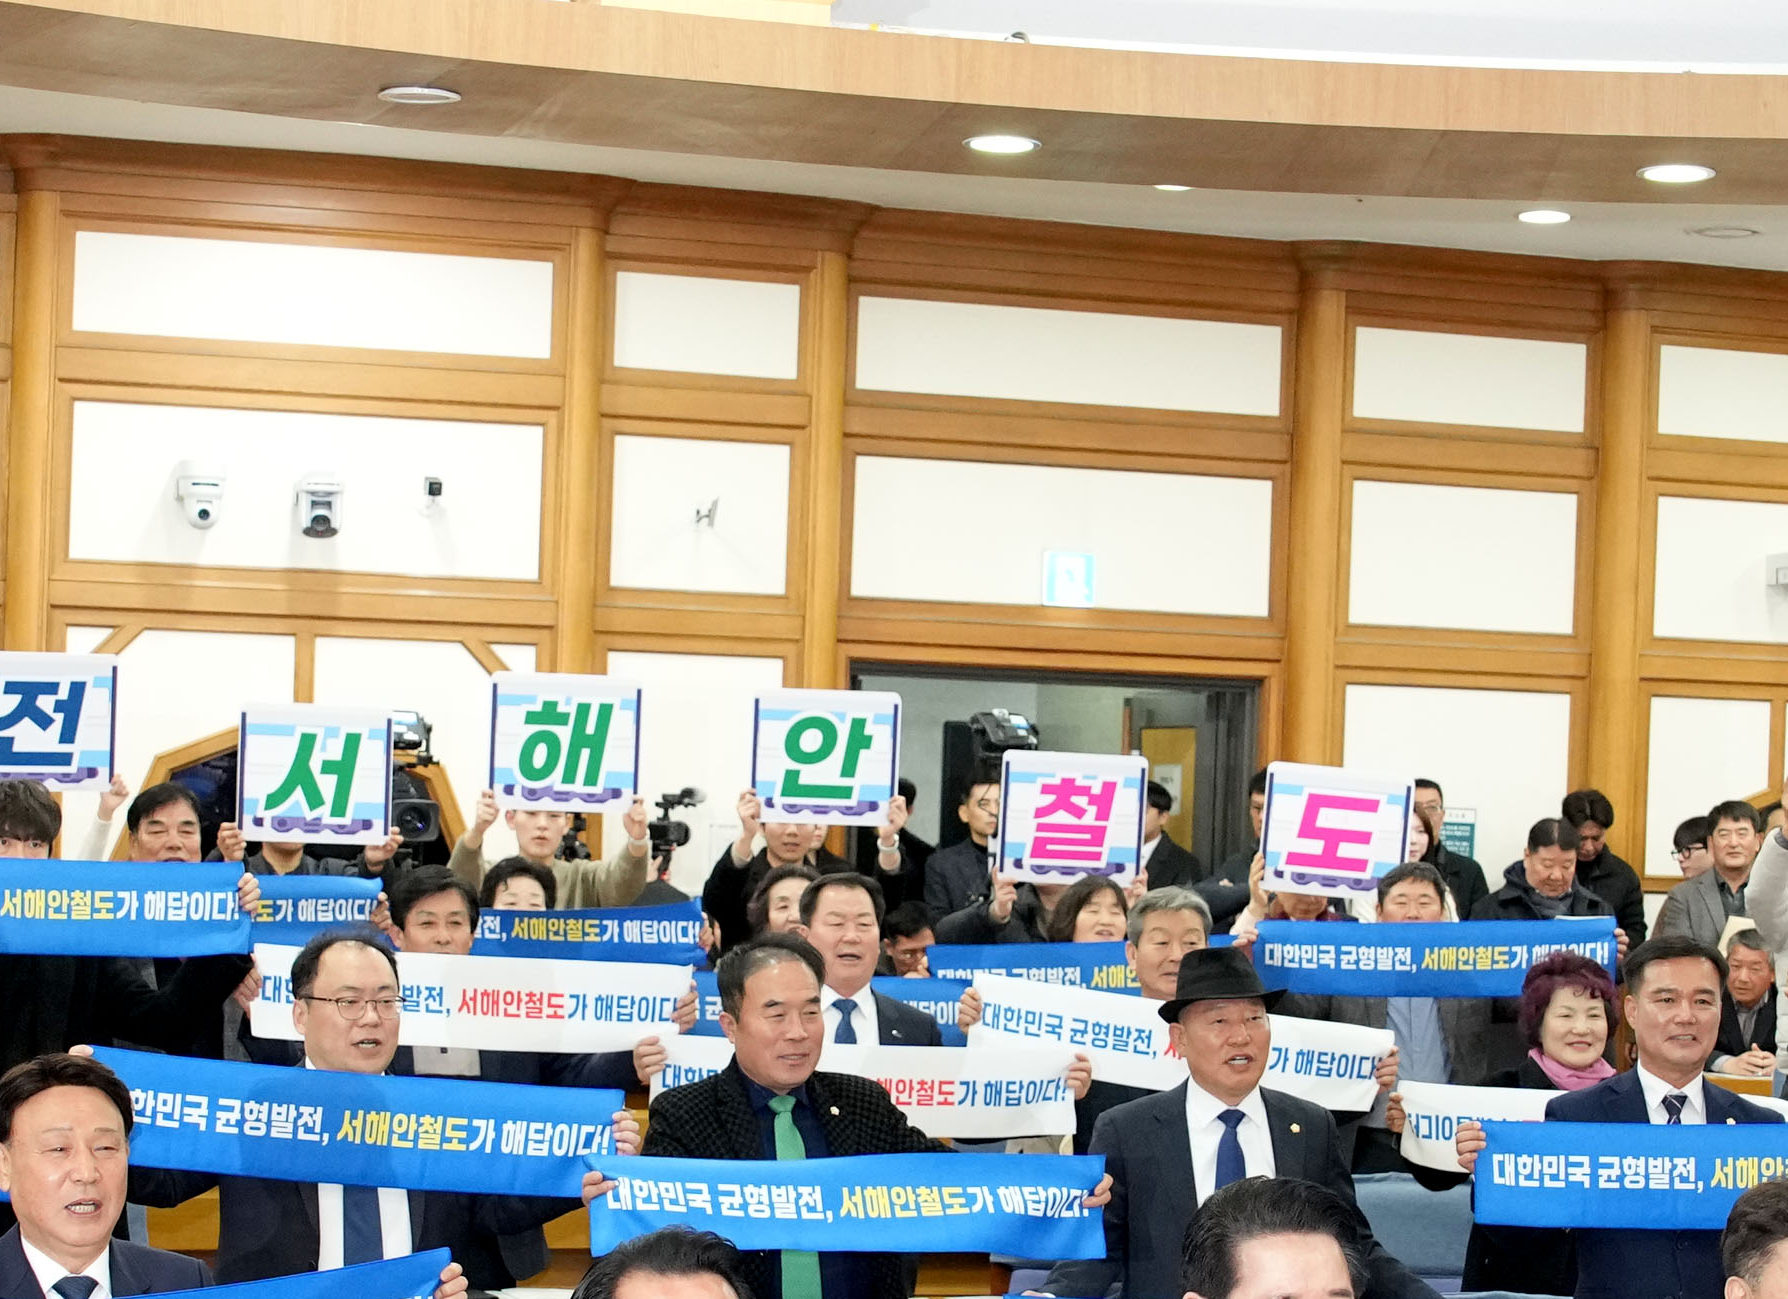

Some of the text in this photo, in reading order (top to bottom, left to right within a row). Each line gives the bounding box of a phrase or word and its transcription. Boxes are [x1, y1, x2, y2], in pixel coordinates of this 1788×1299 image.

[519, 701, 612, 787] 해
[781, 716, 872, 800] 안
[264, 733, 361, 819] 서
[1032, 777, 1113, 863] 철
[1285, 794, 1380, 872] 도
[0, 889, 138, 921] 서해안철도가
[144, 891, 240, 922] 해답이다!
[298, 898, 376, 922] 해답이다!
[512, 919, 618, 943] 서해안철도가
[624, 919, 700, 944] 해답이다!
[1265, 944, 1336, 968] 대한민국
[1341, 944, 1417, 973] 균형발전,
[1422, 945, 1528, 971] 서해안철도가
[458, 987, 587, 1021] 서해안철도가
[982, 1002, 1063, 1038] 대한민국
[1070, 1015, 1158, 1057] 균형발전,
[984, 1076, 1067, 1107] 해답이다!
[215, 1098, 329, 1147] 균형발전,
[336, 1109, 496, 1154] 서해안철도가
[501, 1121, 609, 1158] 해답이다!
[1492, 1152, 1590, 1186] 대한민국
[1597, 1155, 1705, 1191] 균형발전,
[608, 1178, 1089, 1223] 대한민국 균형발전, 서해안철도가 해답이다!
